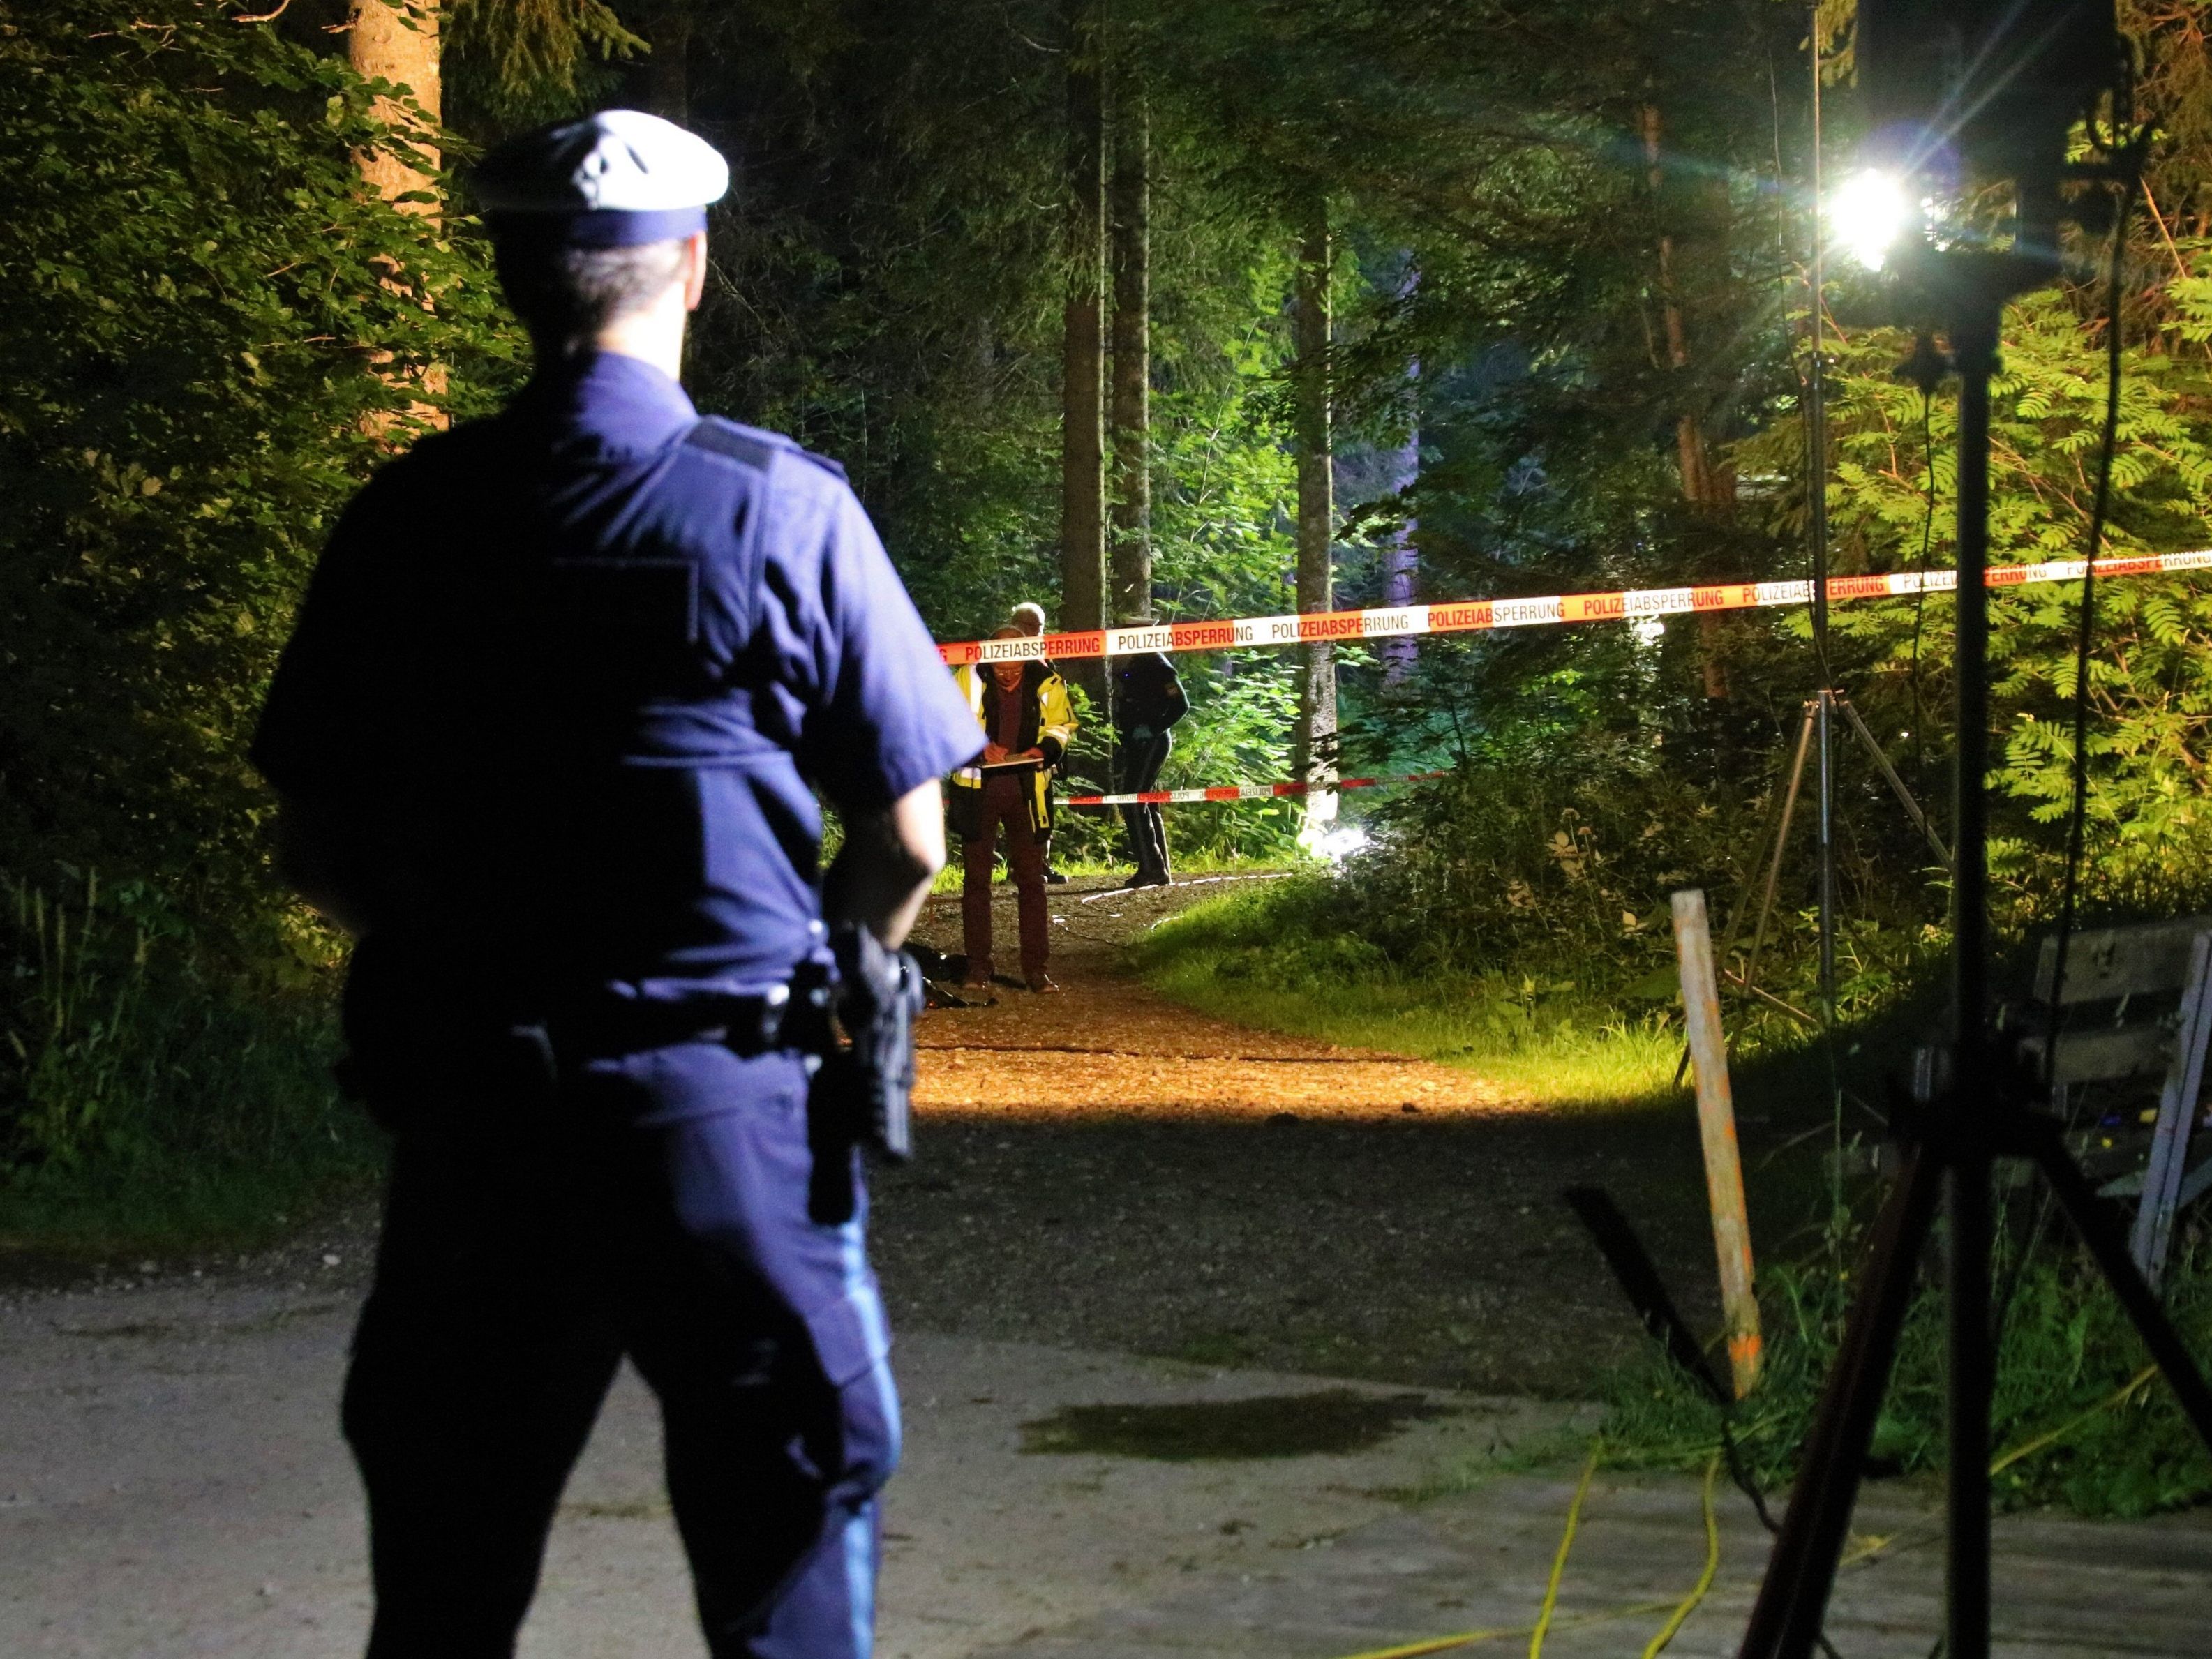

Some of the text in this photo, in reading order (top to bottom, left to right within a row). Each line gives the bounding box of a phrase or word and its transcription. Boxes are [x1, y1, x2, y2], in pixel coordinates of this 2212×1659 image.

[966, 637, 1100, 661] POLIZEIABSPERRUNG
[1119, 625, 1253, 650] POLIZEIABSPERRUNG
[1271, 615, 1408, 639] POLIZEIABSPERRUNG
[1428, 602, 1565, 627] POLIZEIABSPERRUNG
[1584, 590, 1724, 615] POLIZEIABSPERRUNG
[1742, 577, 1884, 603] POLIZEIABERRUNG
